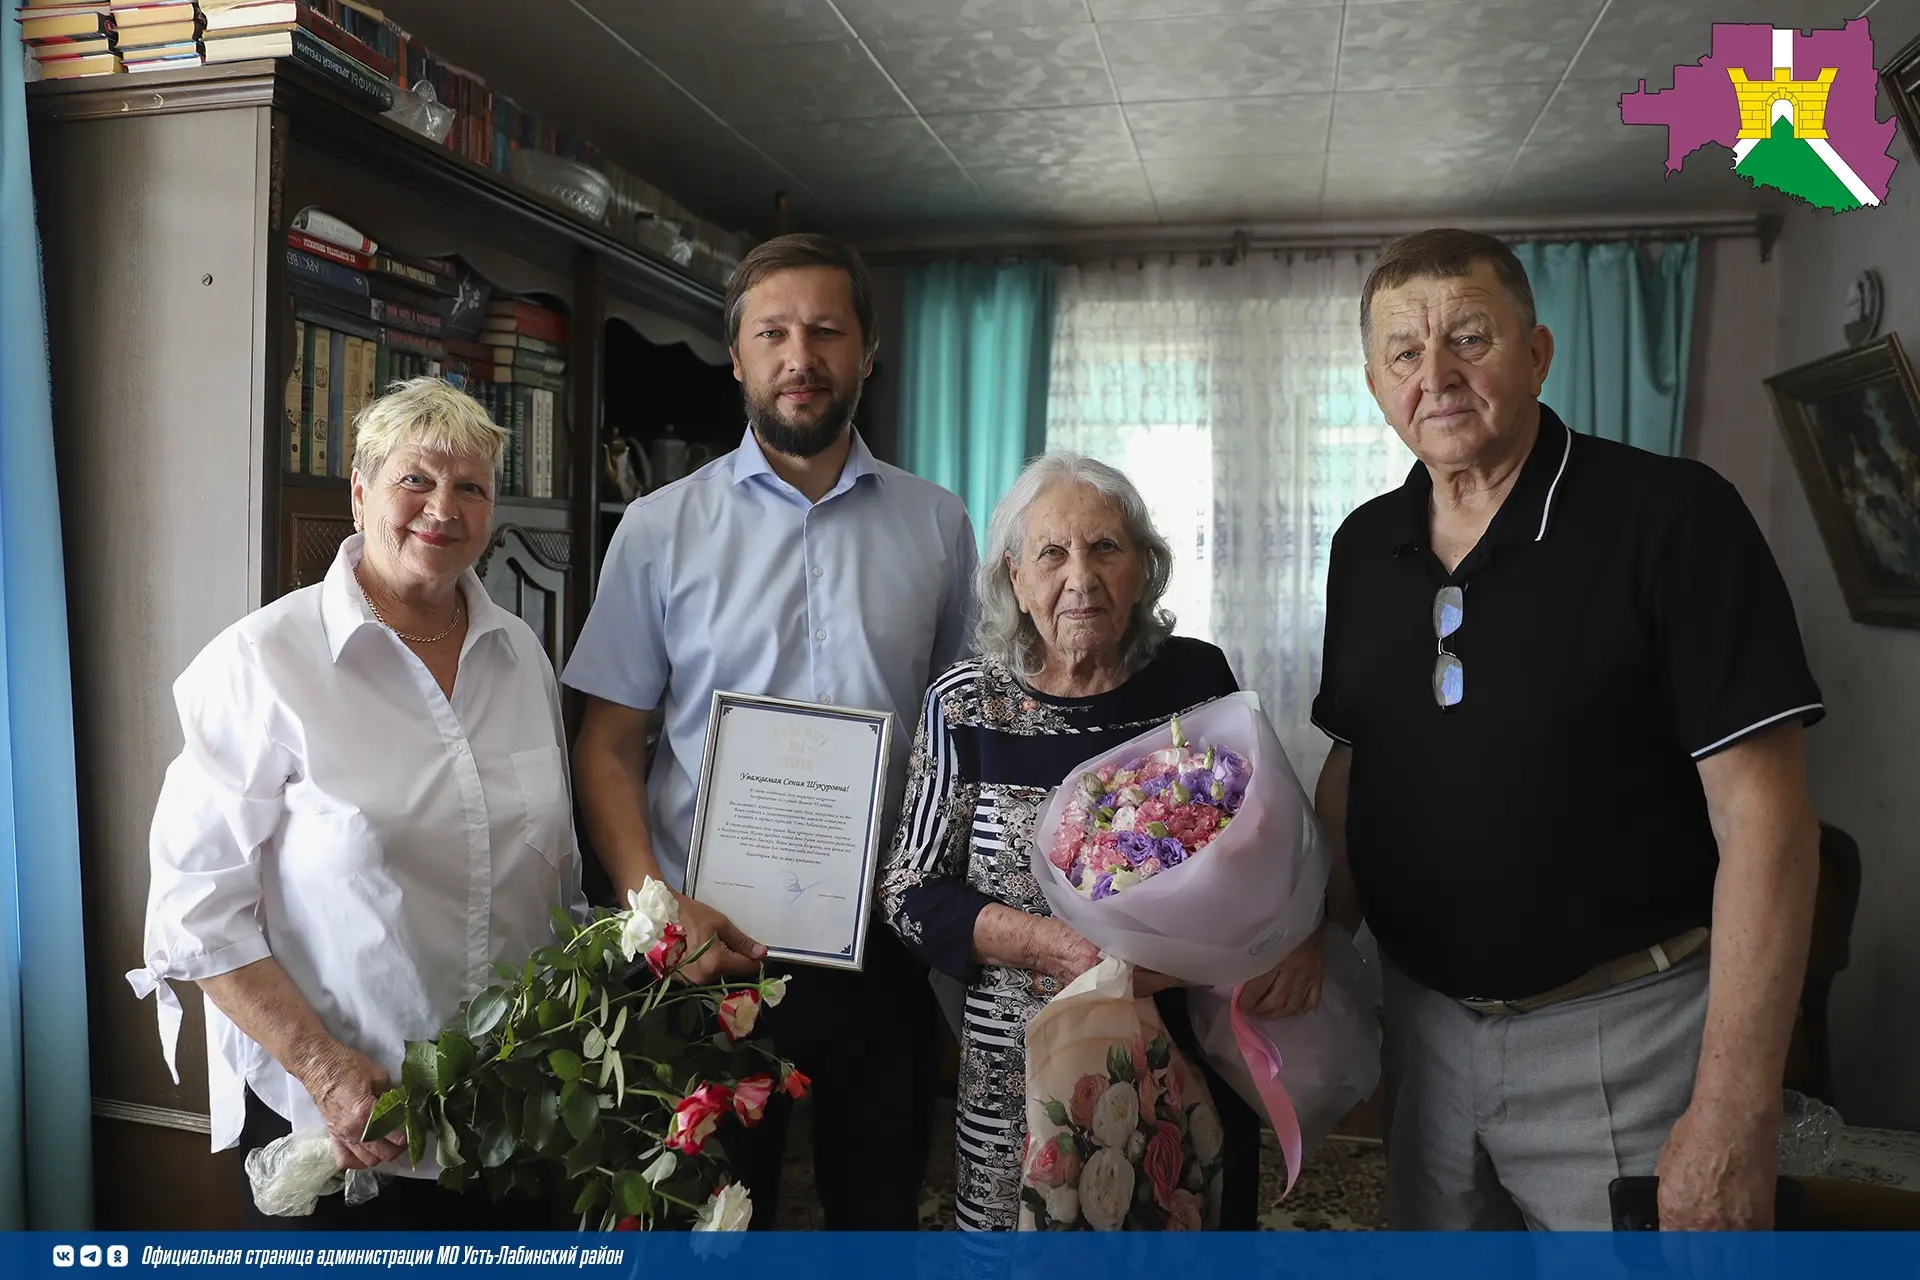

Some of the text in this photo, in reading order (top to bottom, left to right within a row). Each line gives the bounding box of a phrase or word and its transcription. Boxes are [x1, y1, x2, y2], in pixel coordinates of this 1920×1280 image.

[295, 40, 379, 97] МИФЫ ДРЕВНЕЙ ГРЕЦИИ
[738, 772, 849, 794] Уважаемая Сения Шукуровна!
